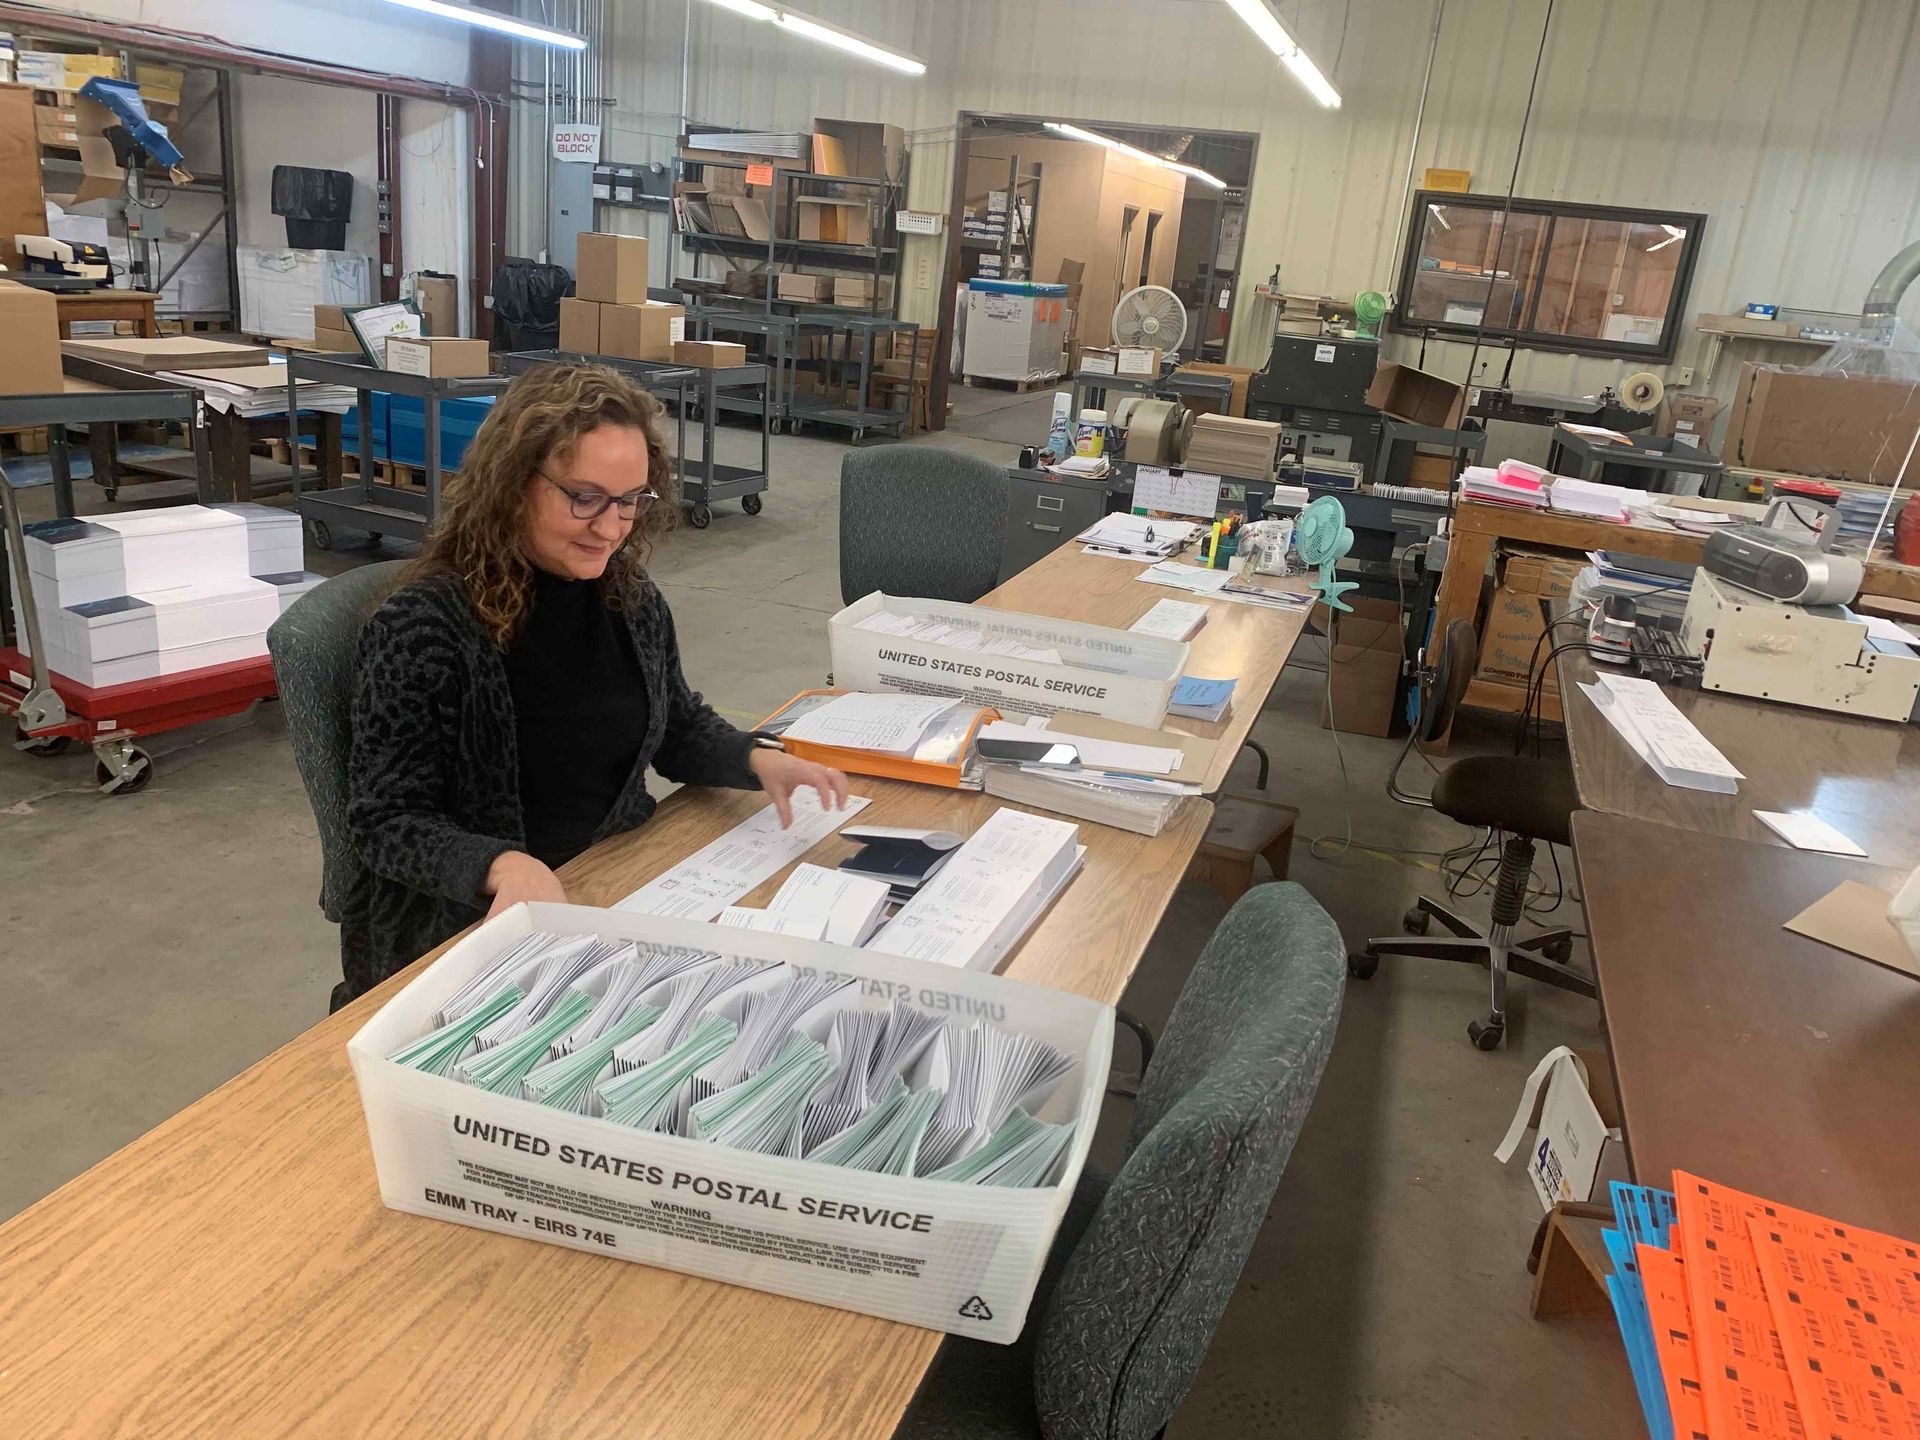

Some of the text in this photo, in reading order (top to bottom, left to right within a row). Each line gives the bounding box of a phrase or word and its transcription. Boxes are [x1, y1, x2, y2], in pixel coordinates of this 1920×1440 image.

[556, 133, 598, 143] DO NOT
[558, 144, 592, 154] BLOCK
[878, 648, 927, 667] UNITED
[930, 658, 982, 678] STATES
[985, 669, 1040, 688] POSTAL
[1044, 679, 1107, 699] SERVICE
[973, 685, 1002, 696] WARNING
[453, 1114, 934, 1233] UNITED STATES POSTAL SERVICE
[1538, 1136, 1550, 1172] 4
[424, 1188, 466, 1212] EMM
[470, 1200, 518, 1224] TRAY
[534, 1216, 578, 1238] EIRS
[582, 1228, 617, 1247] 74E
[458, 1159, 473, 1169] THIS
[474, 1164, 512, 1179] EQUIPMENT
[514, 1174, 528, 1184] MAY
[530, 1179, 544, 1188] NOT
[544, 1183, 555, 1191] BE
[556, 1186, 576, 1196] SOLD
[576, 1191, 588, 1199] OR
[588, 1194, 627, 1208] RECYCLED
[628, 1203, 660, 1216] WITHOUT
[662, 1211, 676, 1219] THE
[678, 1214, 724, 1229] PERMISSION
[724, 1224, 735, 1232] OF
[736, 1227, 751, 1235] THE
[752, 1230, 765, 1238] US
[765, 1232, 794, 1243] POSTAL
[832, 1244, 848, 1253] USE
[848, 1247, 860, 1255] OF
[861, 1250, 879, 1258] THIS
[880, 1253, 926, 1266] EQUIPMENT
[462, 1173, 481, 1184] USES
[482, 1179, 525, 1195] ELECTRONIC
[526, 1190, 560, 1204] TRACKING
[561, 1199, 611, 1217] TECHNOLOGY
[611, 1211, 620, 1219] TO
[621, 1214, 656, 1227] MONITOR
[655, 1222, 670, 1230] THE
[670, 1225, 708, 1238] LOCATION
[720, 1236, 738, 1245] THIS
[784, 1248, 828, 1262] VIOLATORS
[828, 1257, 844, 1265] ARE
[846, 1260, 881, 1272] SUBJECT
[881, 1266, 893, 1274] TO
[901, 1269, 920, 1278] FINE
[466, 1168, 481, 1177] FOR
[481, 1172, 496, 1181] ANY
[496, 1176, 529, 1190] PURPOSE
[530, 1185, 554, 1196] OTHER
[554, 1191, 574, 1201] THAN
[574, 1196, 589, 1205] THE
[588, 1199, 631, 1215] TRANSPORT
[632, 1210, 644, 1218] OF
[644, 1213, 656, 1221] US
[656, 1215, 674, 1225] MAIL
[674, 1219, 683, 1227] IS
[684, 1221, 718, 1235] STRICTLY
[720, 1229, 765, 1244] PROHIBITED
[766, 1238, 779, 1247] BY
[780, 1241, 814, 1253] FEDERAL
[834, 1251, 849, 1260] THE
[851, 1254, 881, 1265] POSTAL
[882, 1260, 916, 1271] SERVICE
[504, 1190, 514, 1198] OF
[515, 1193, 524, 1201] UP
[558, 1204, 569, 1212] OR
[624, 1220, 635, 1228] OF
[636, 1223, 648, 1231] UP
[658, 1228, 675, 1237] ONE
[710, 1239, 731, 1249] BOTH
[731, 1244, 748, 1253] FOR
[750, 1248, 770, 1257] EACH
[650, 1200, 712, 1220] WARNING
